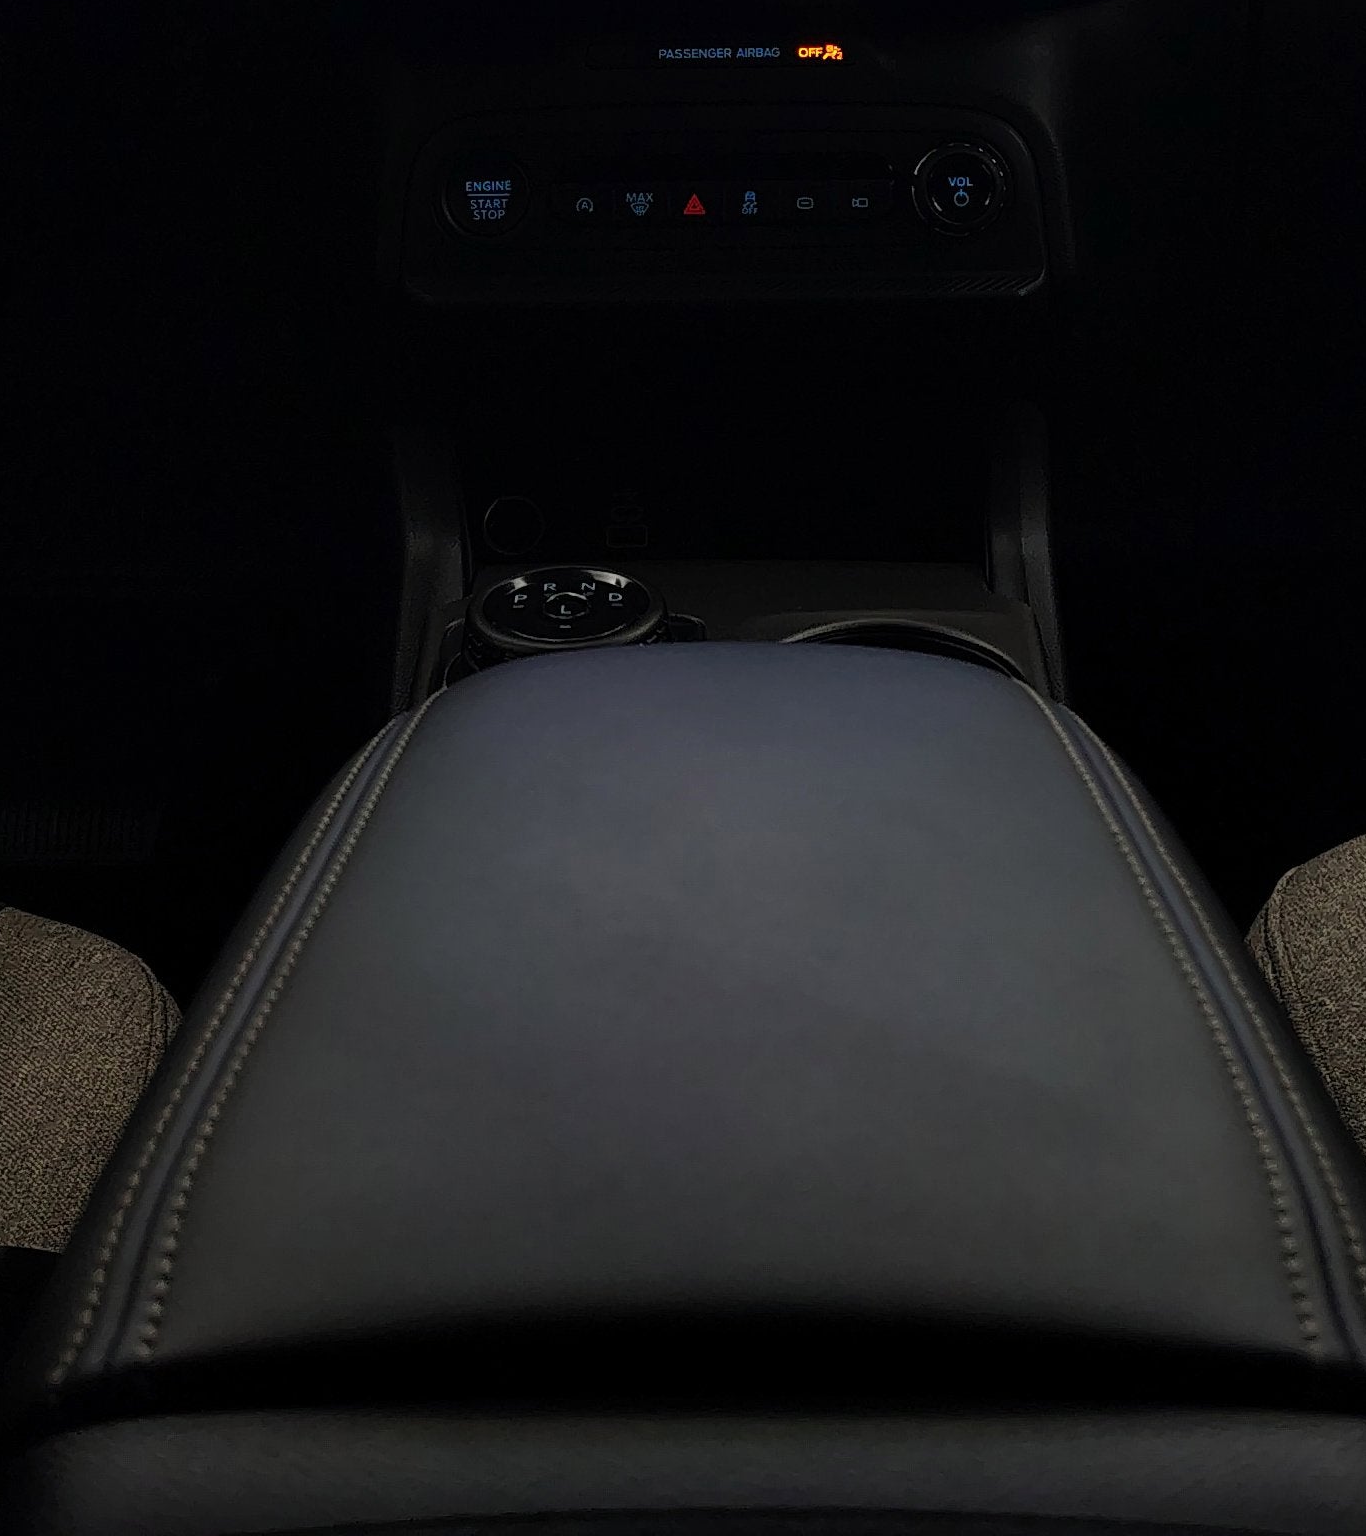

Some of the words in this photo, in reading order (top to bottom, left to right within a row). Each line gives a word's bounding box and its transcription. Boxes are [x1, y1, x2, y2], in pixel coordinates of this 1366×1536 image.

[658, 48, 732, 60] PASSENGER
[736, 47, 781, 58] AIRBAG
[798, 47, 824, 58] OFF
[466, 180, 513, 193] ENGINE
[948, 176, 974, 187] VOL
[626, 192, 655, 204] MAX
[470, 198, 507, 210] START
[473, 209, 506, 220] STOP
[741, 207, 759, 216] OFF
[543, 583, 557, 592] R
[581, 582, 595, 591] N
[514, 594, 527, 604] P
[608, 592, 623, 602] D
[560, 605, 571, 614] L
